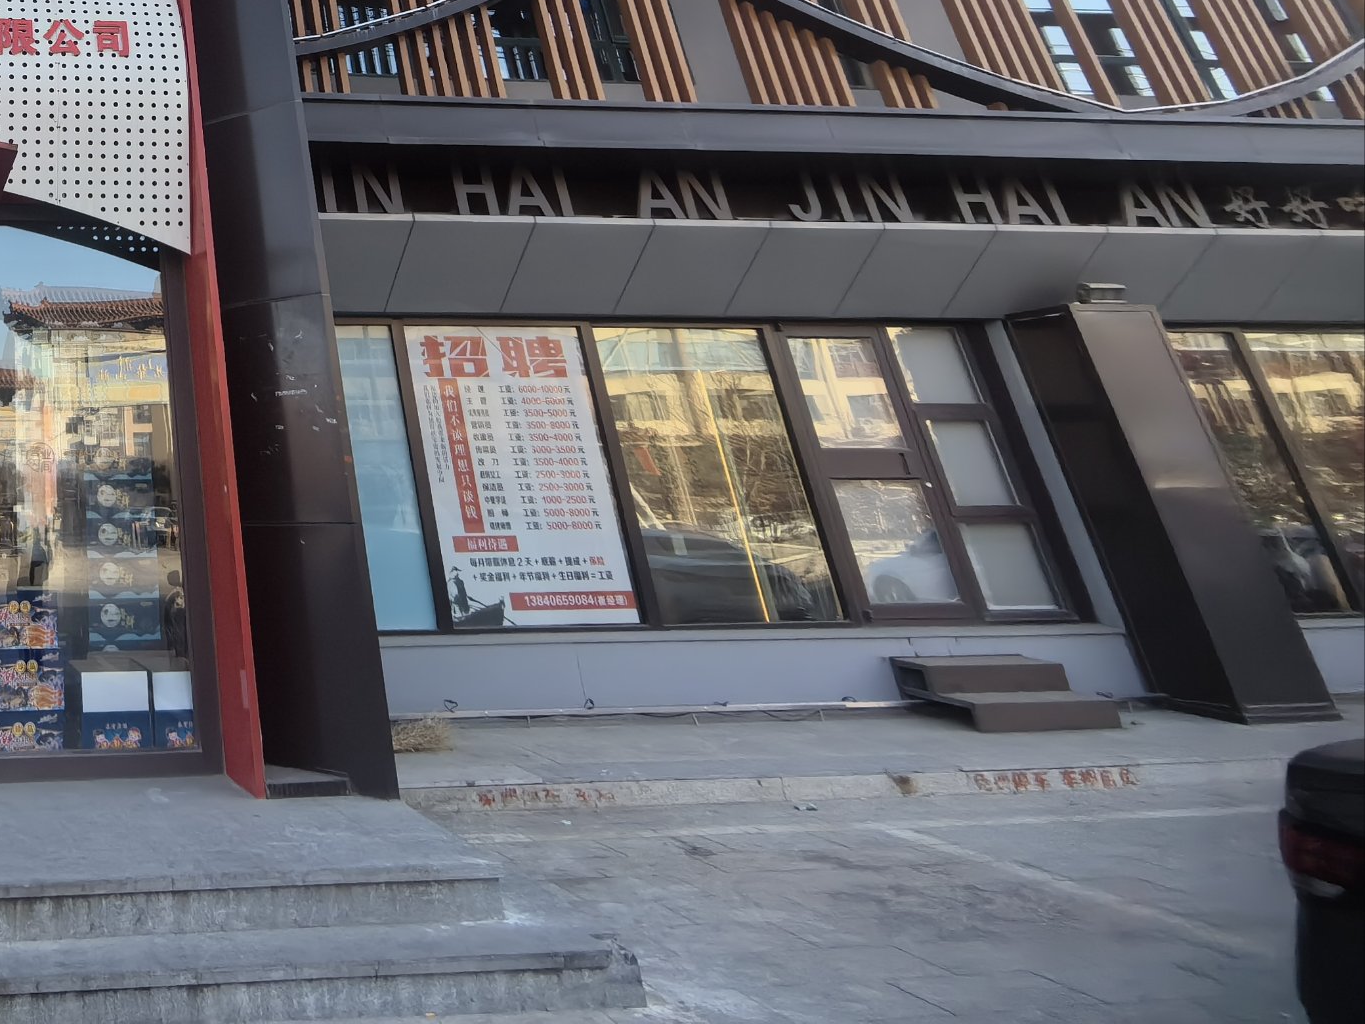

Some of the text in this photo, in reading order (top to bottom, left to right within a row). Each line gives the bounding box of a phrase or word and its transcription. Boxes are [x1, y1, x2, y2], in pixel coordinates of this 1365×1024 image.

[451, 162, 575, 217] HAI
[637, 166, 737, 220] AN
[787, 172, 915, 223] JIN
[950, 174, 1071, 225] HAI
[1118, 177, 1215, 228] AN
[420, 335, 568, 378] 招聘
